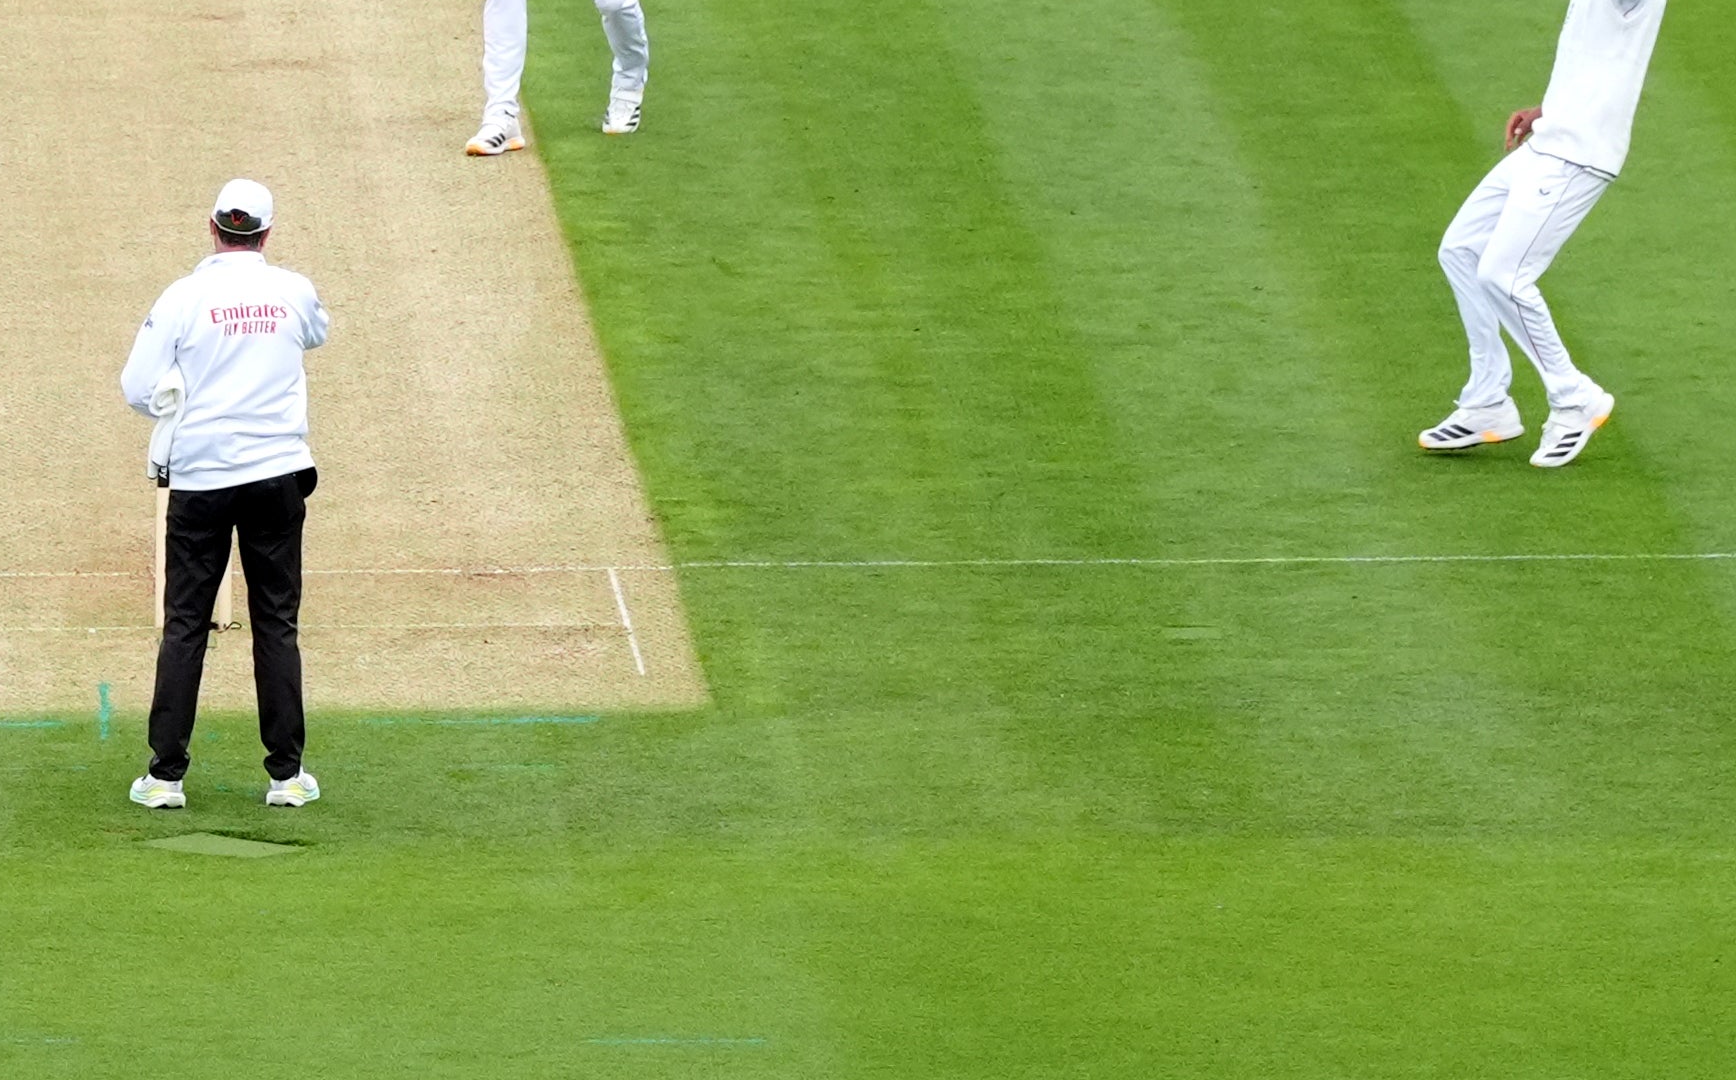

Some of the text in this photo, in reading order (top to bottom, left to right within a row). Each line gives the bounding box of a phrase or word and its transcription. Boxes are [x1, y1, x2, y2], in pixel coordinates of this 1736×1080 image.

[209, 302, 288, 325] Emirates
[223, 320, 277, 337] FLY BETTER
